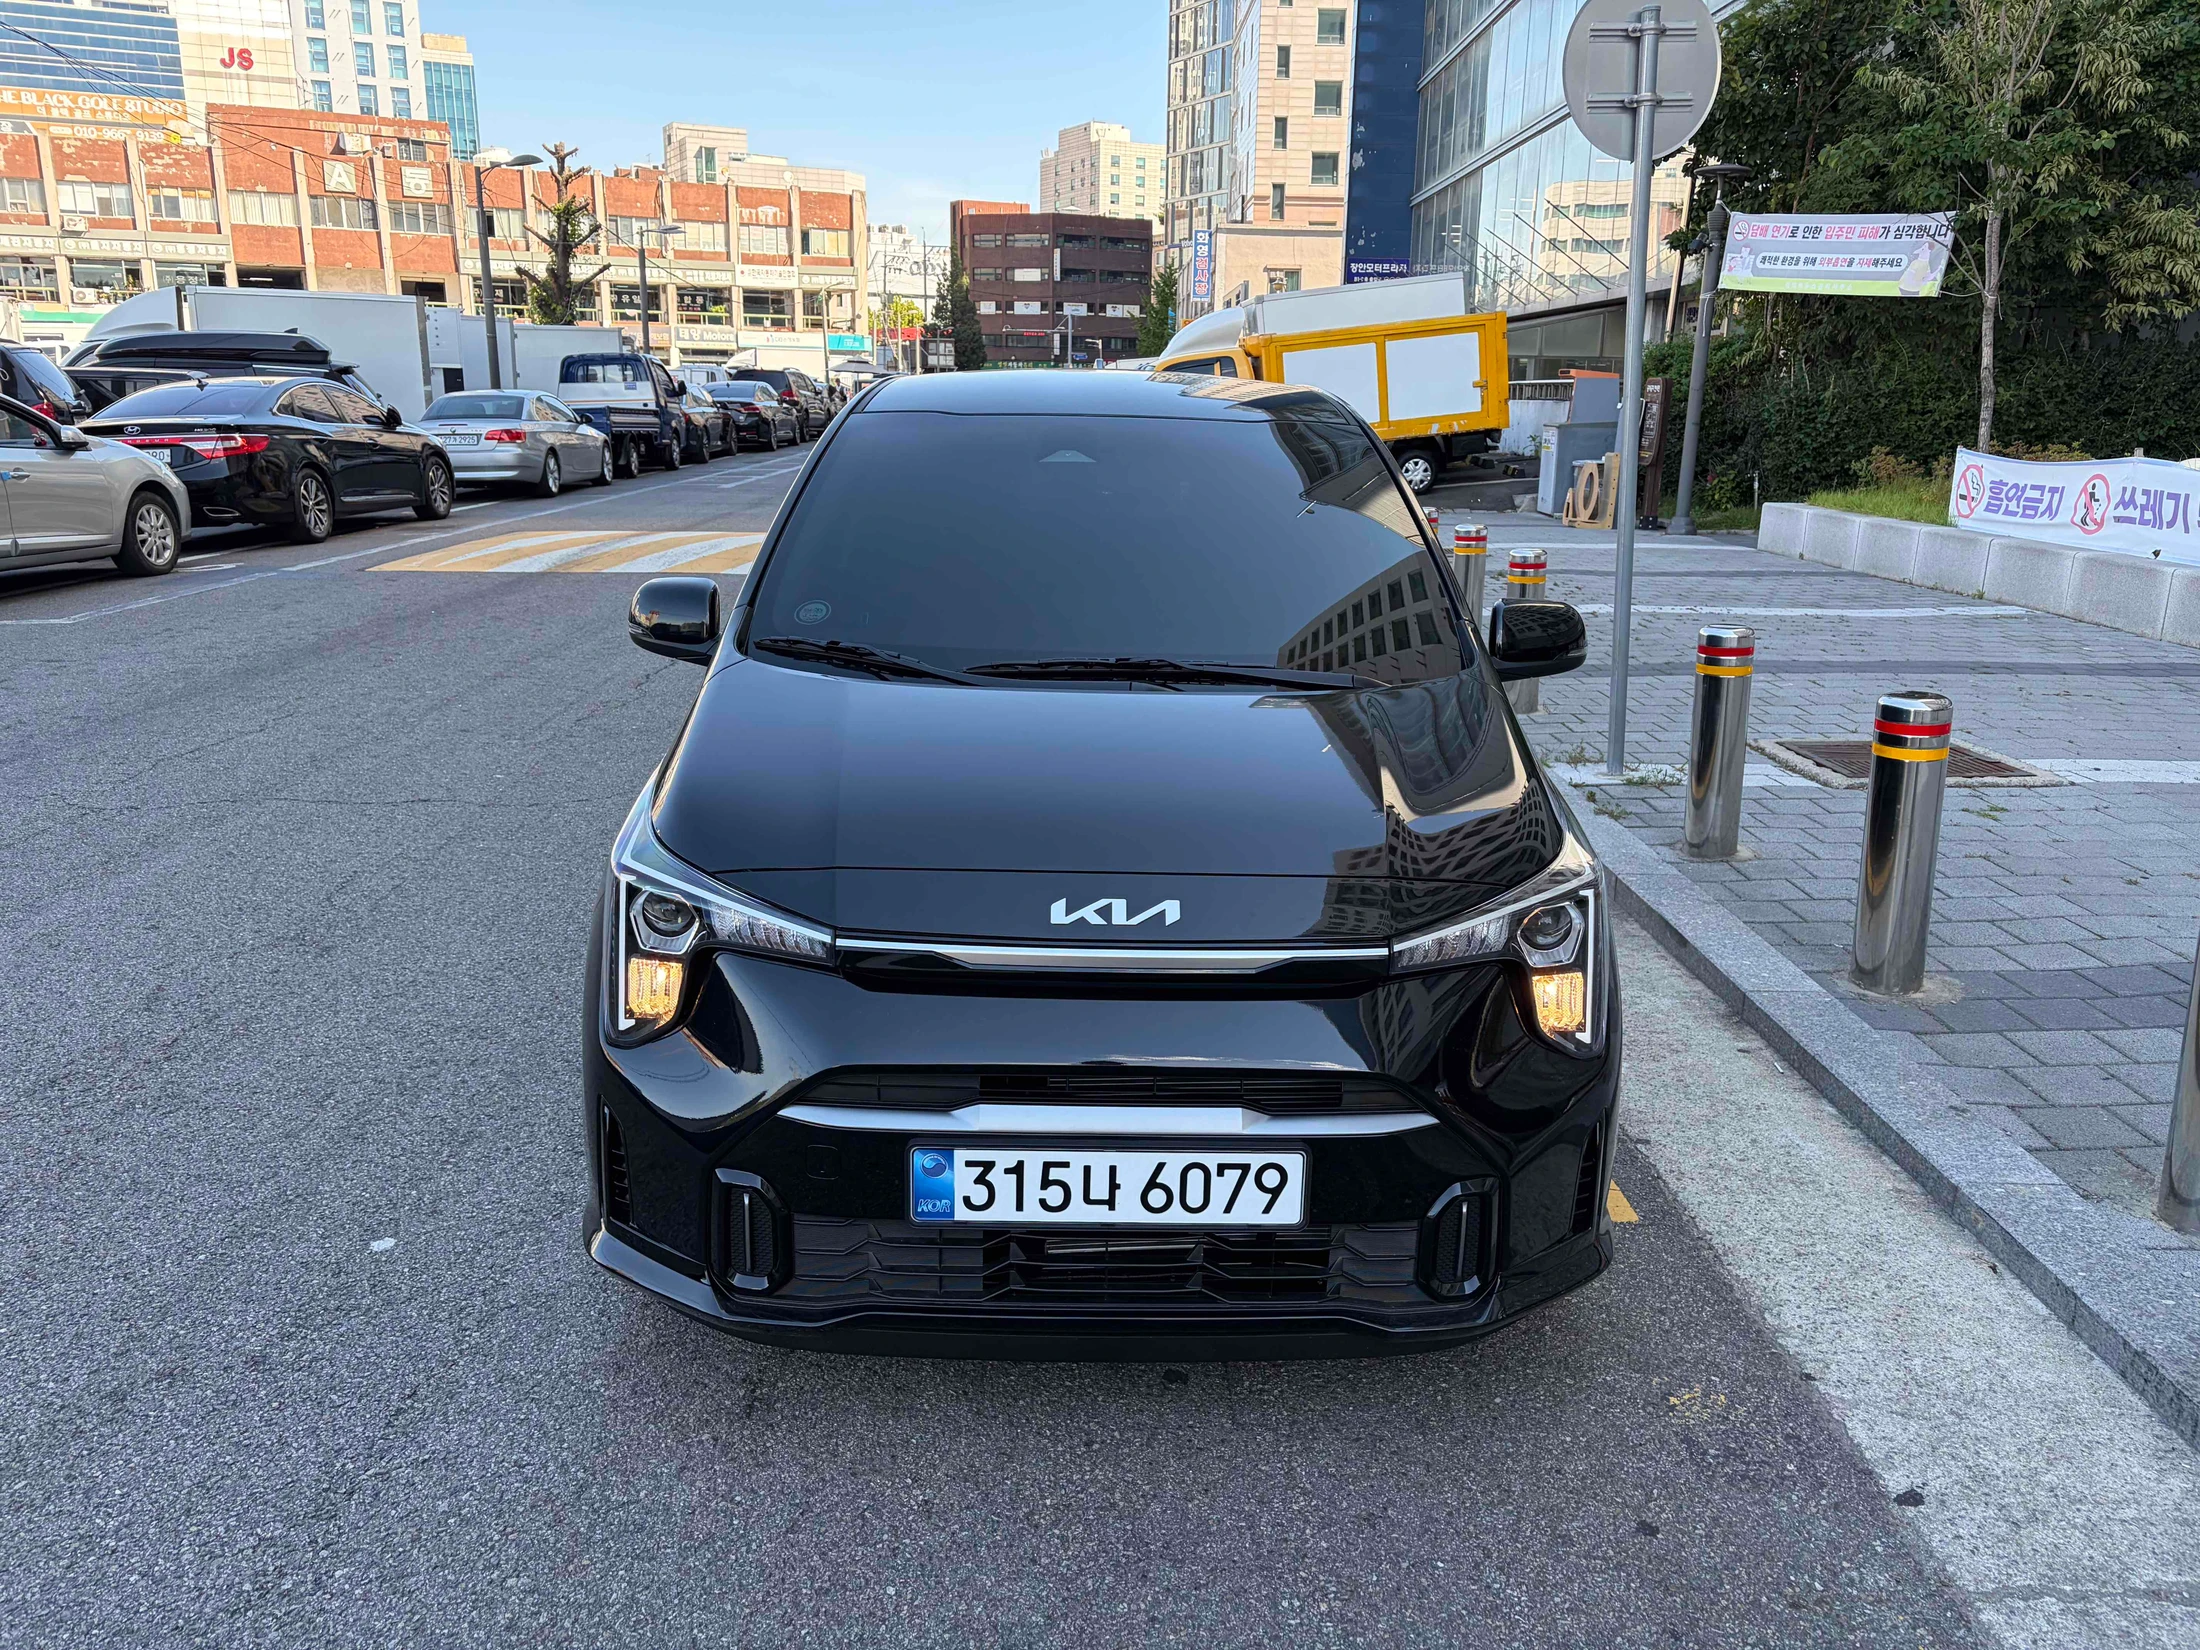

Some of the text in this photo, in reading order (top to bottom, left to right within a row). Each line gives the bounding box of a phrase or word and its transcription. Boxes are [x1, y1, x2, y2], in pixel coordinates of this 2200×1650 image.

[220, 47, 253, 70] JS
[21, 91, 74, 107] BLACK
[328, 163, 429, 194] A 동
[1750, 224, 1949, 240] 담배 연기로 인한 입주민 피해가 심각합니다
[1759, 255, 1903, 268] 쾌적한 환경을 위해 외부흡연을 자제해주세요
[1983, 479, 2065, 521] 흡연금지
[2113, 486, 2190, 534] 쓰레기
[1051, 898, 1181, 926] KIA
[962, 1160, 1288, 1214] 315나 6079
[917, 1198, 951, 1213] KOR
